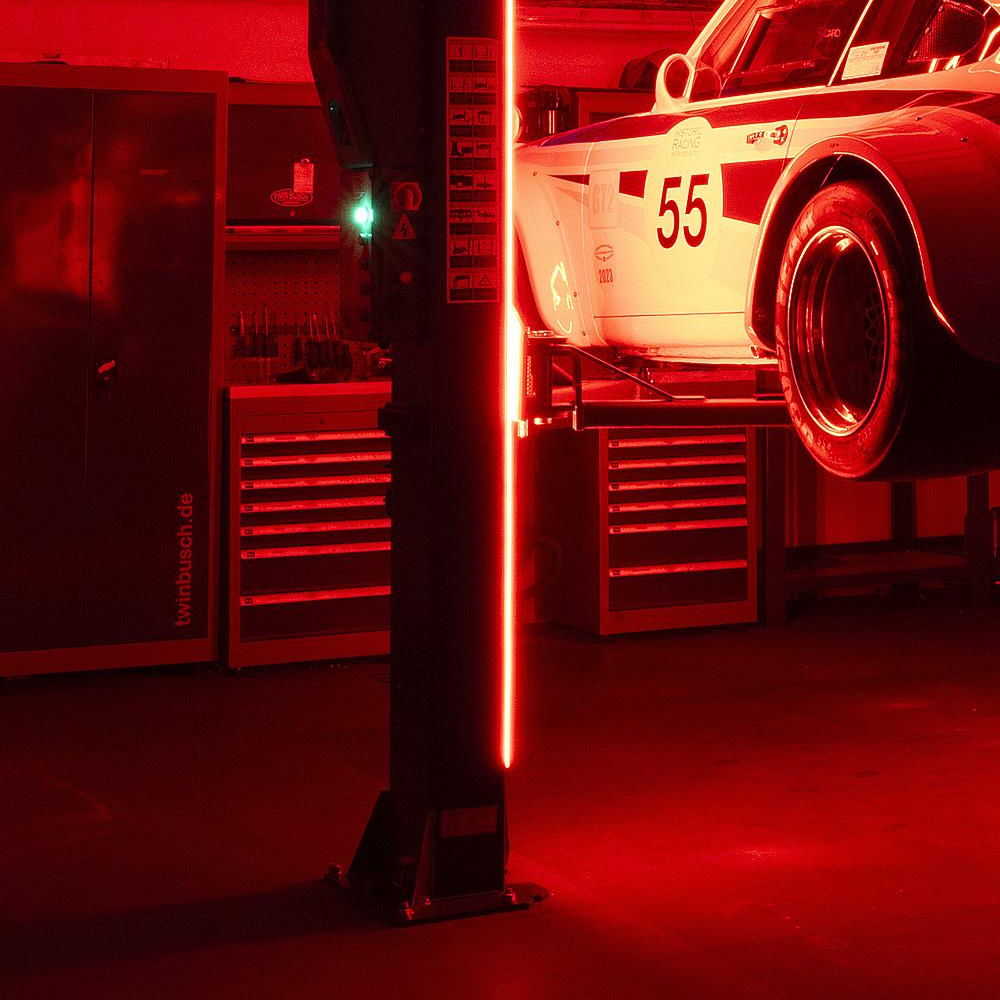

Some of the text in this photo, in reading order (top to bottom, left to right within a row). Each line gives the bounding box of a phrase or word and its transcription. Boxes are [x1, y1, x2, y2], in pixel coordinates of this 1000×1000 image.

[672, 136, 701, 151] RACING
[674, 126, 704, 138] HISTORIC
[592, 183, 614, 215] GT2
[656, 173, 710, 249] 55
[598, 268, 613, 284] 2023
[174, 492, 194, 627] twinbusch.de
